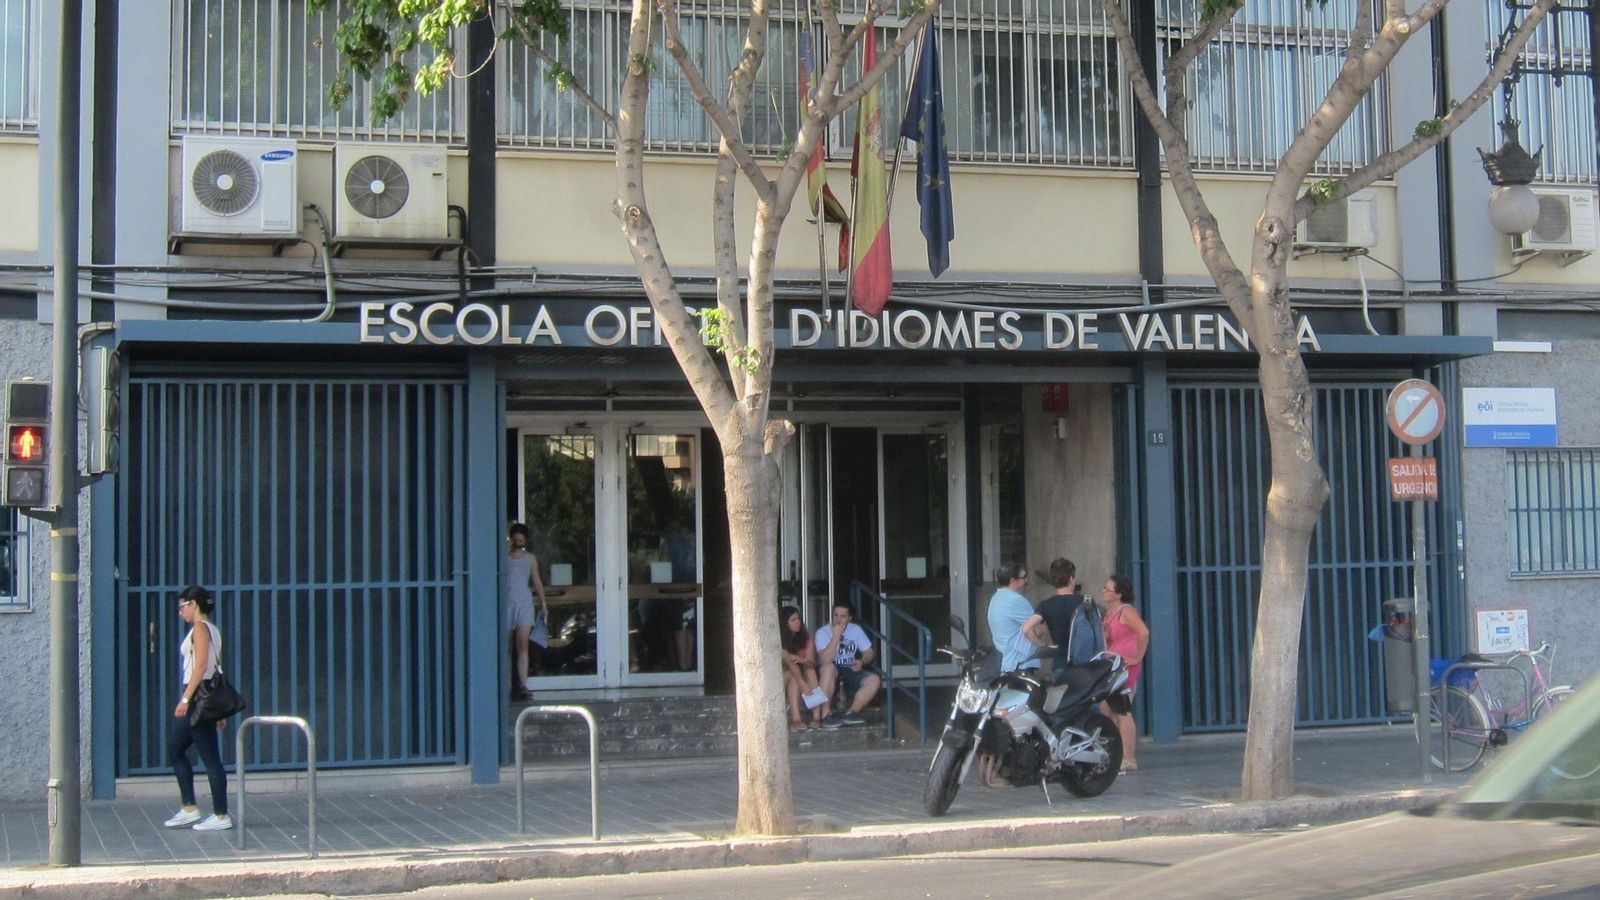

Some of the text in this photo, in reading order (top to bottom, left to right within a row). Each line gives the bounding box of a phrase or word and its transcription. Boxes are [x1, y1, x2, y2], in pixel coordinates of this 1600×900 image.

[360, 302, 562, 345] ESCOLA
[789, 308, 1023, 350] D'IDIOMES
[1044, 311, 1099, 350] DE
[1117, 312, 1322, 351] VALENA
[1153, 432, 1164, 443] 19
[1392, 463, 1428, 477] SALIDA
